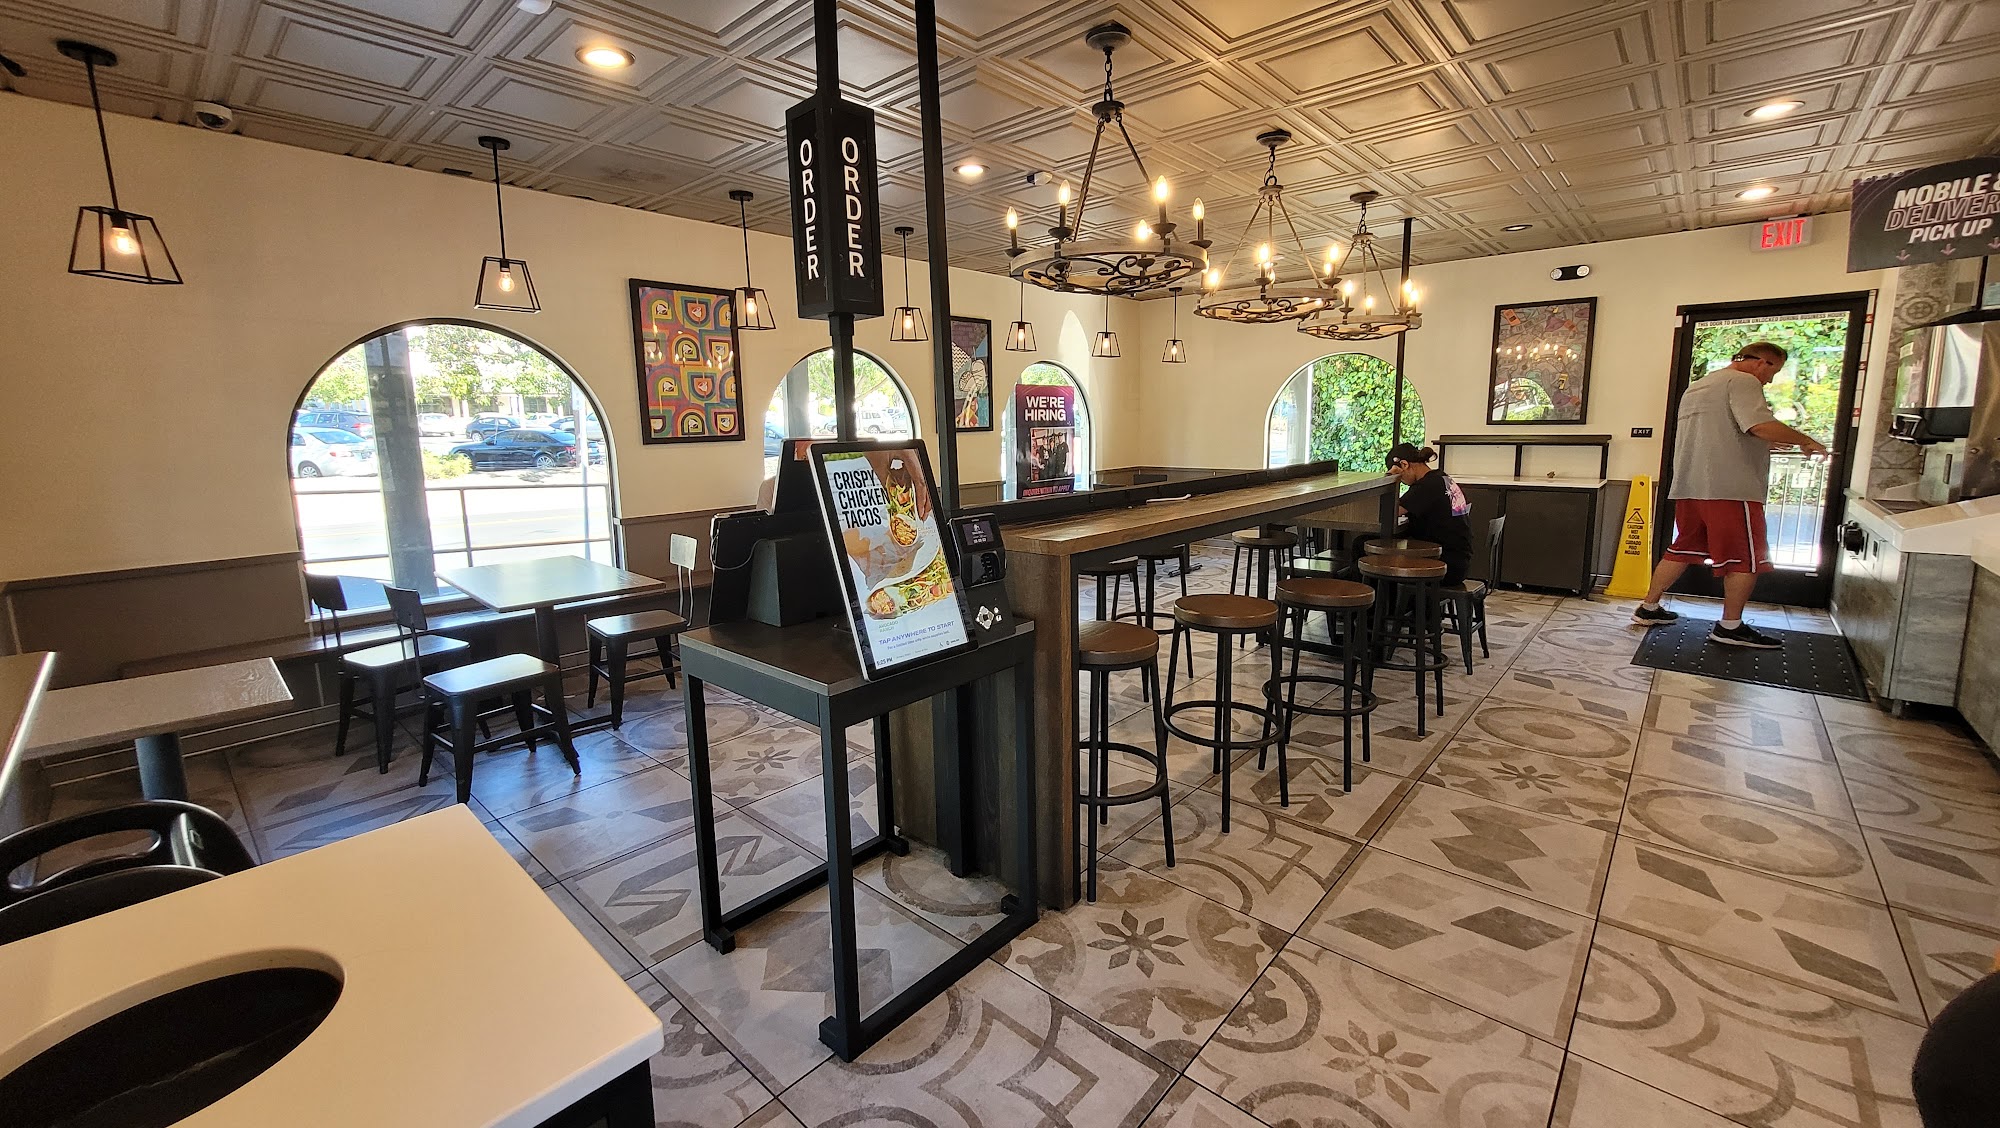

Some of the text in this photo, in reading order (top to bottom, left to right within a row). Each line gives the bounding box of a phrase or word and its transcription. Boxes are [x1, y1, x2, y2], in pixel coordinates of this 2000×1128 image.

[1893, 173, 1992, 210] MOBILE
[800, 139, 819, 280] ORDER
[841, 136, 865, 277] ORDER
[1761, 218, 1806, 249] EXIT
[1908, 218, 1993, 244] PICK UP
[1026, 396, 1065, 409] WE'RE
[1024, 409, 1067, 421] HIRING
[833, 469, 876, 490] CRISPY
[838, 488, 890, 509] CHICKEN
[842, 507, 882, 529] TACOS
[878, 620, 899, 629] AVOCADO
[891, 628, 927, 642] ANYWHERE
[936, 620, 955, 630] START
